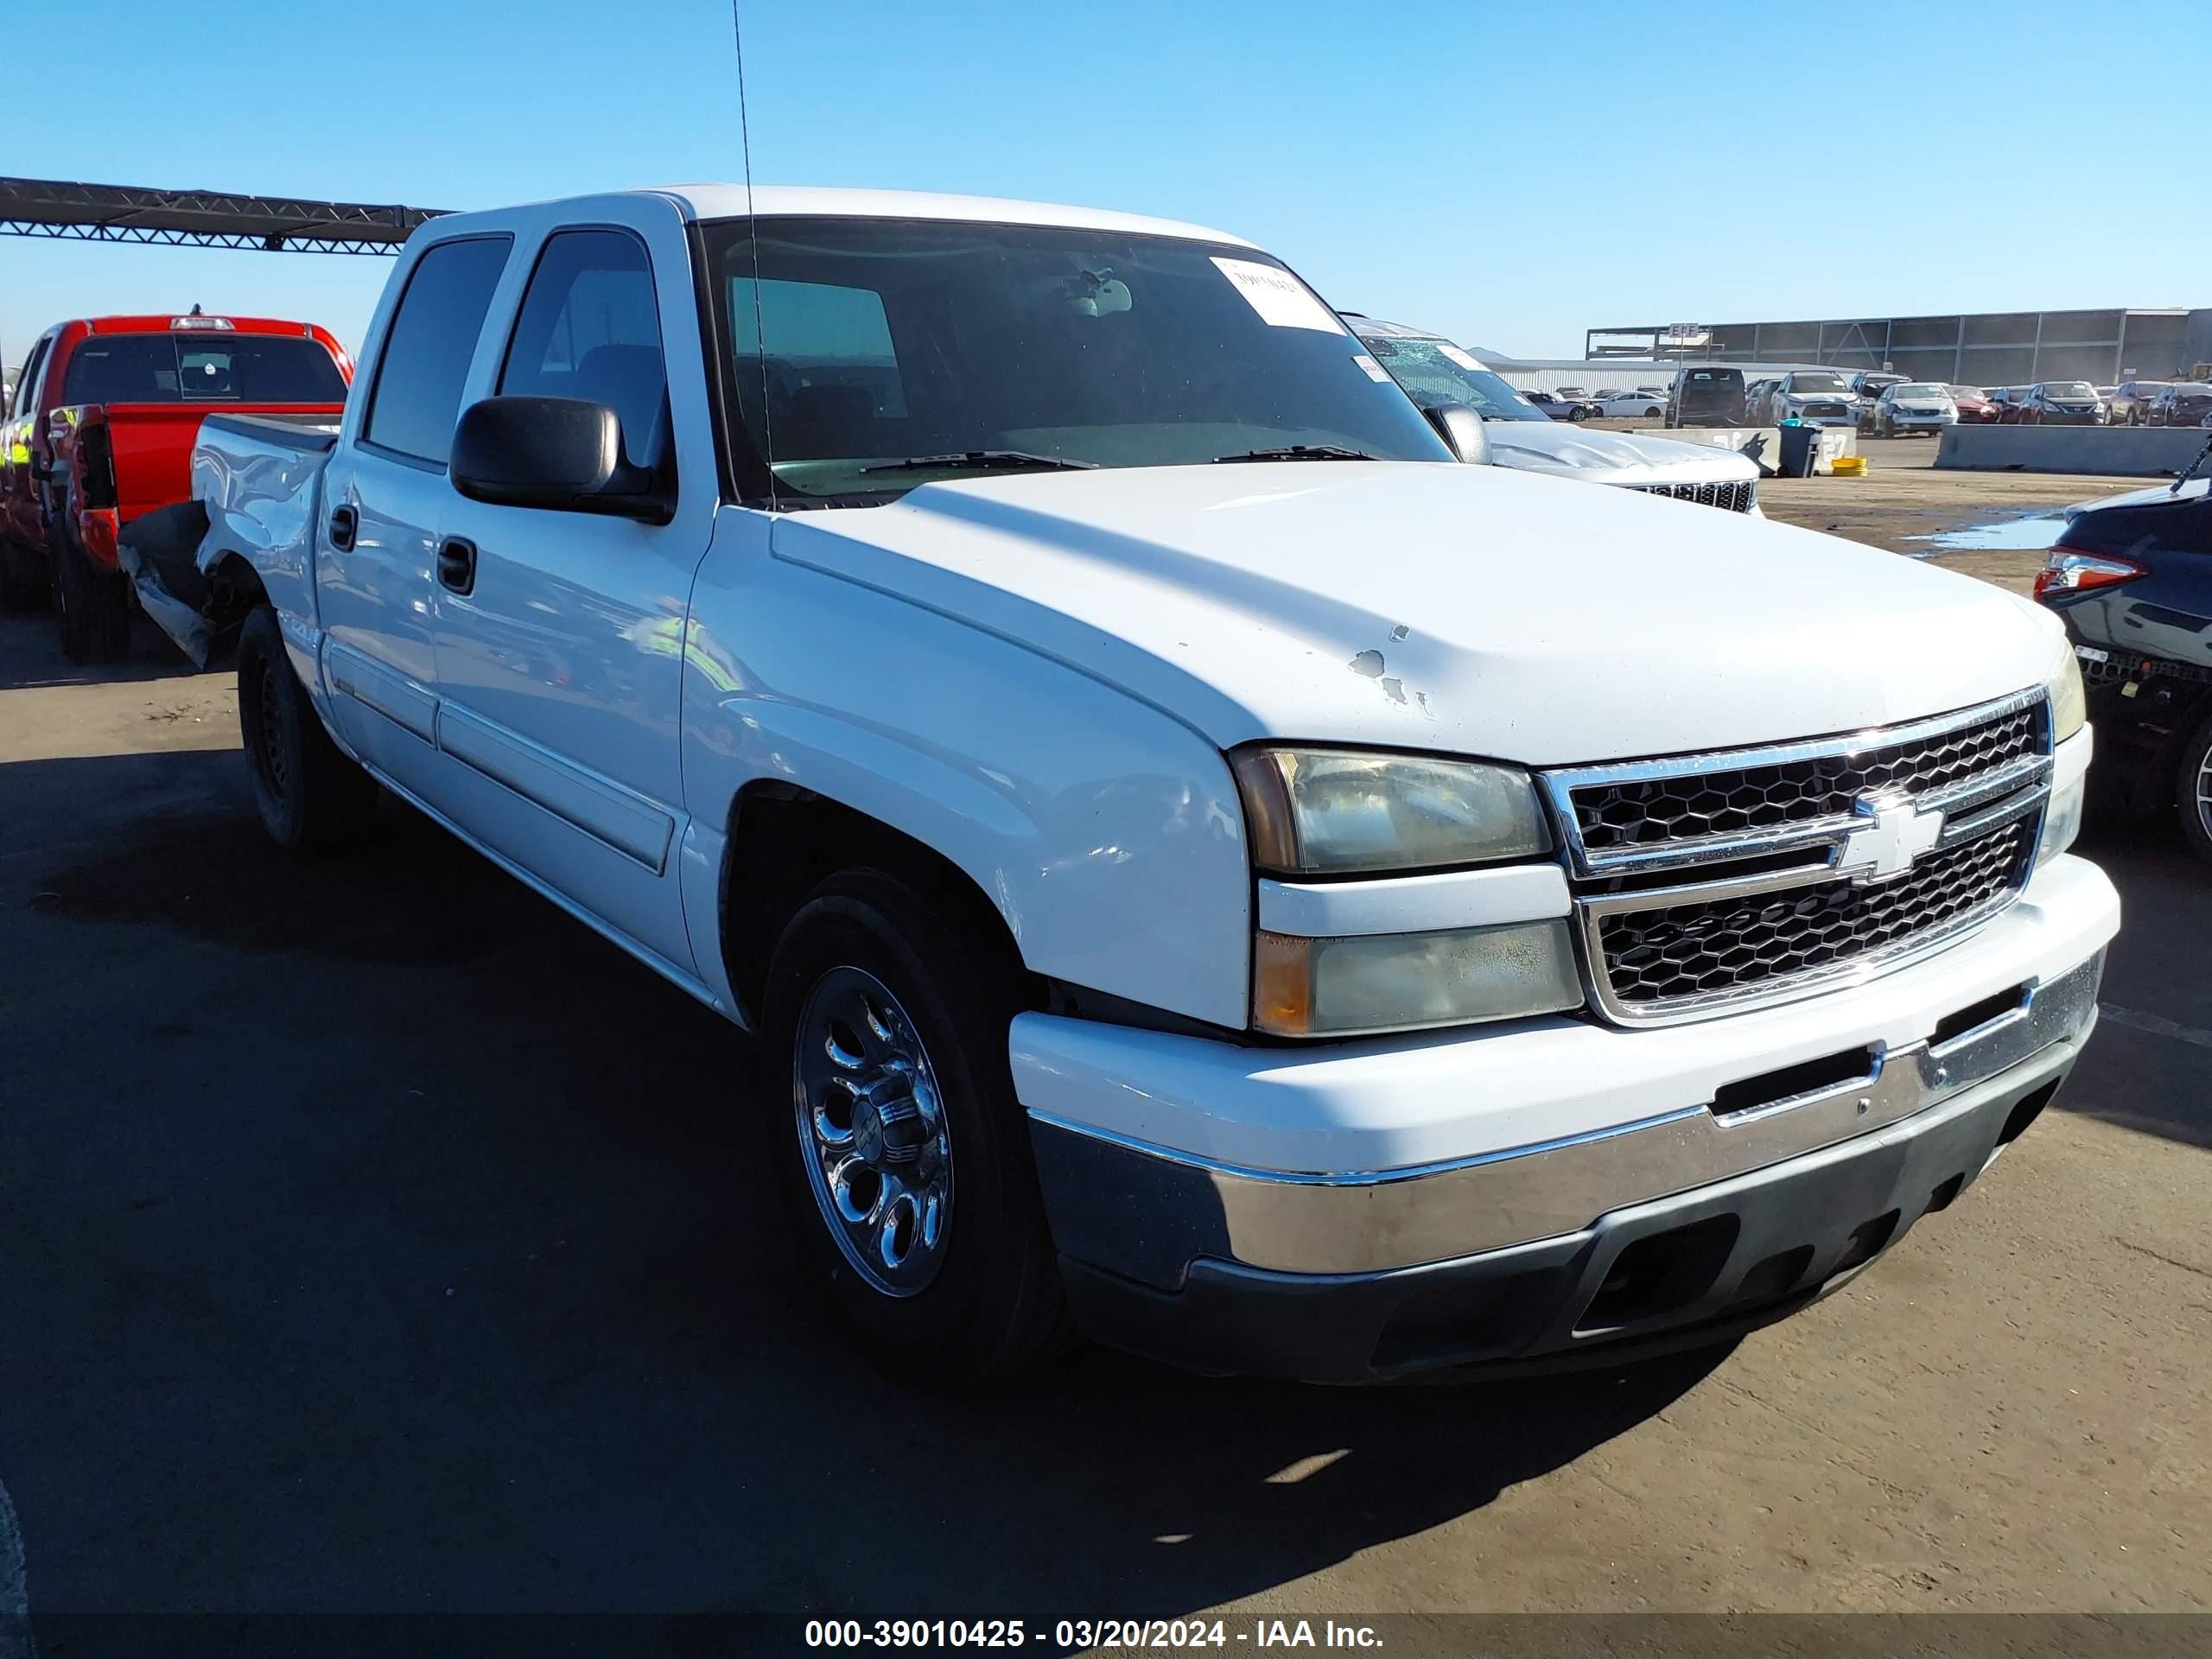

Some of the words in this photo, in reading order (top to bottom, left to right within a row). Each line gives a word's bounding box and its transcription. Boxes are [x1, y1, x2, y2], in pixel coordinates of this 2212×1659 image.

[1672, 326, 1679, 336] E
[1688, 326, 1694, 336] F
[1823, 435, 1847, 462] 27
